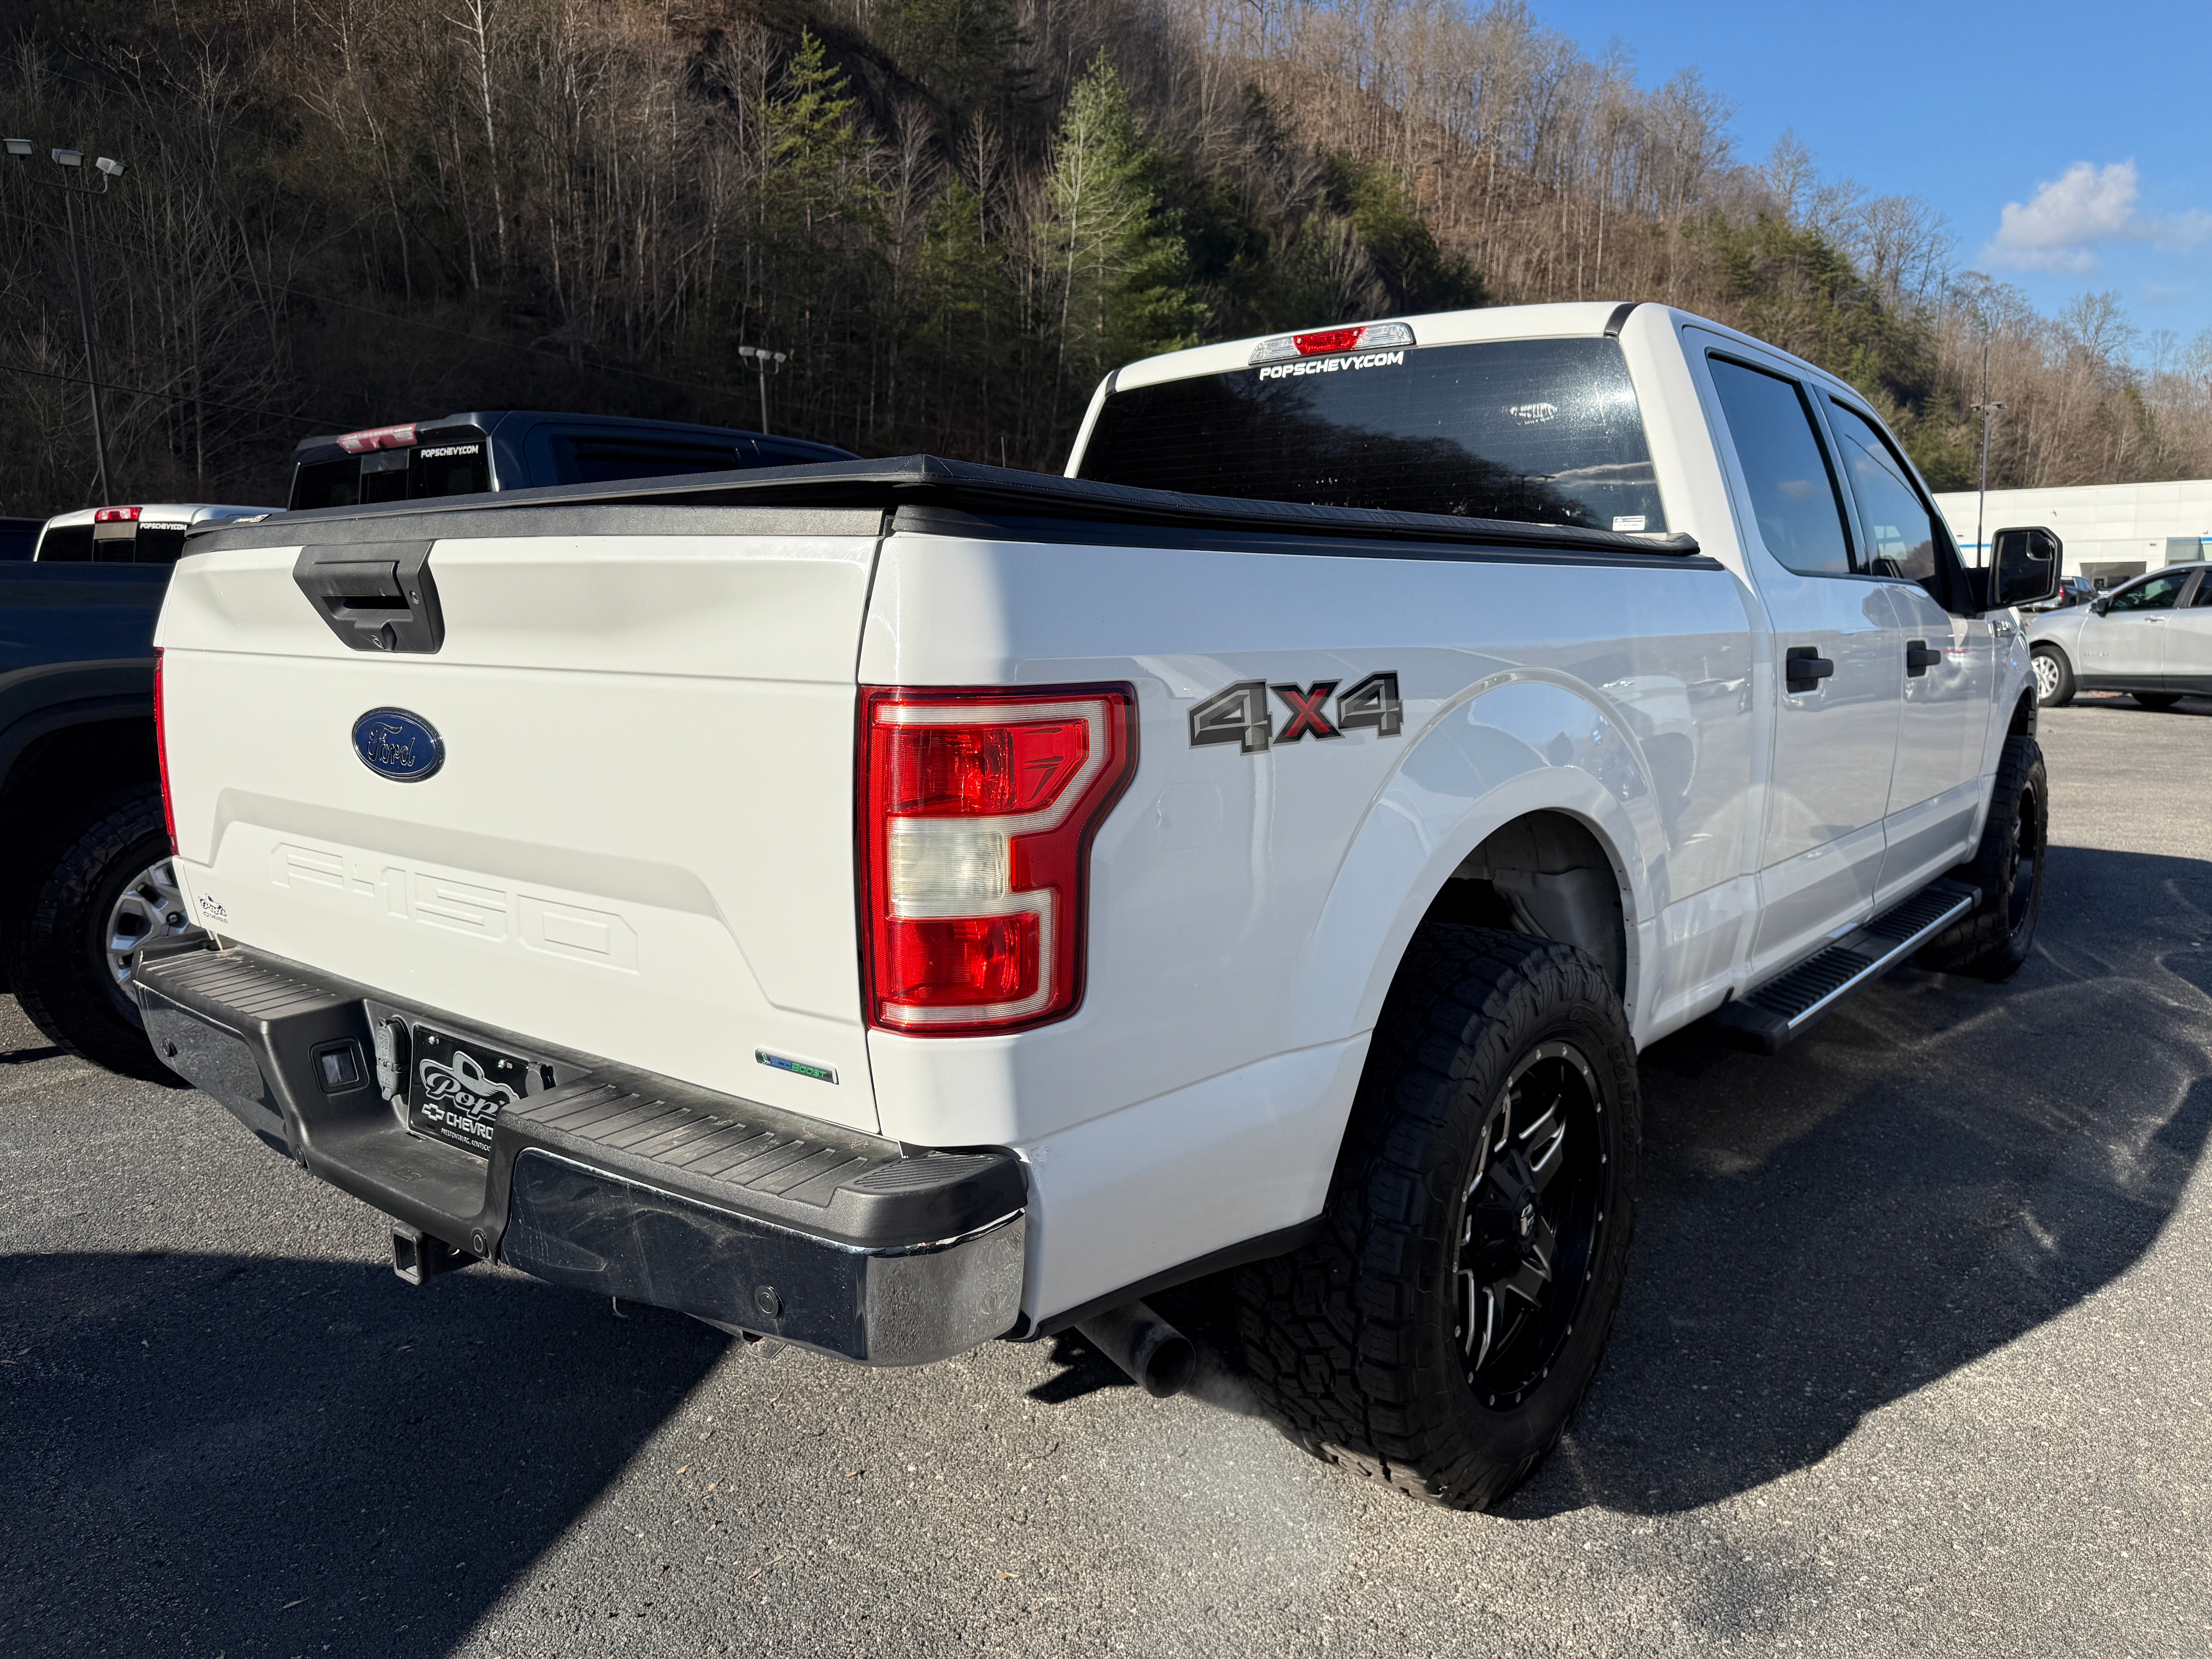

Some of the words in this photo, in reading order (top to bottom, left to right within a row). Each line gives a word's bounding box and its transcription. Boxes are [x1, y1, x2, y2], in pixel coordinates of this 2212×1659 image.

[1259, 351, 1404, 381] POPSCHEVY.COM
[421, 445, 479, 459] POPSCHEVY.COM
[367, 722, 416, 766] Ford
[270, 842, 639, 975] F-150
[441, 1128, 471, 1145] PRESTONSBURG,
[471, 1140, 491, 1152] KENTUCK
